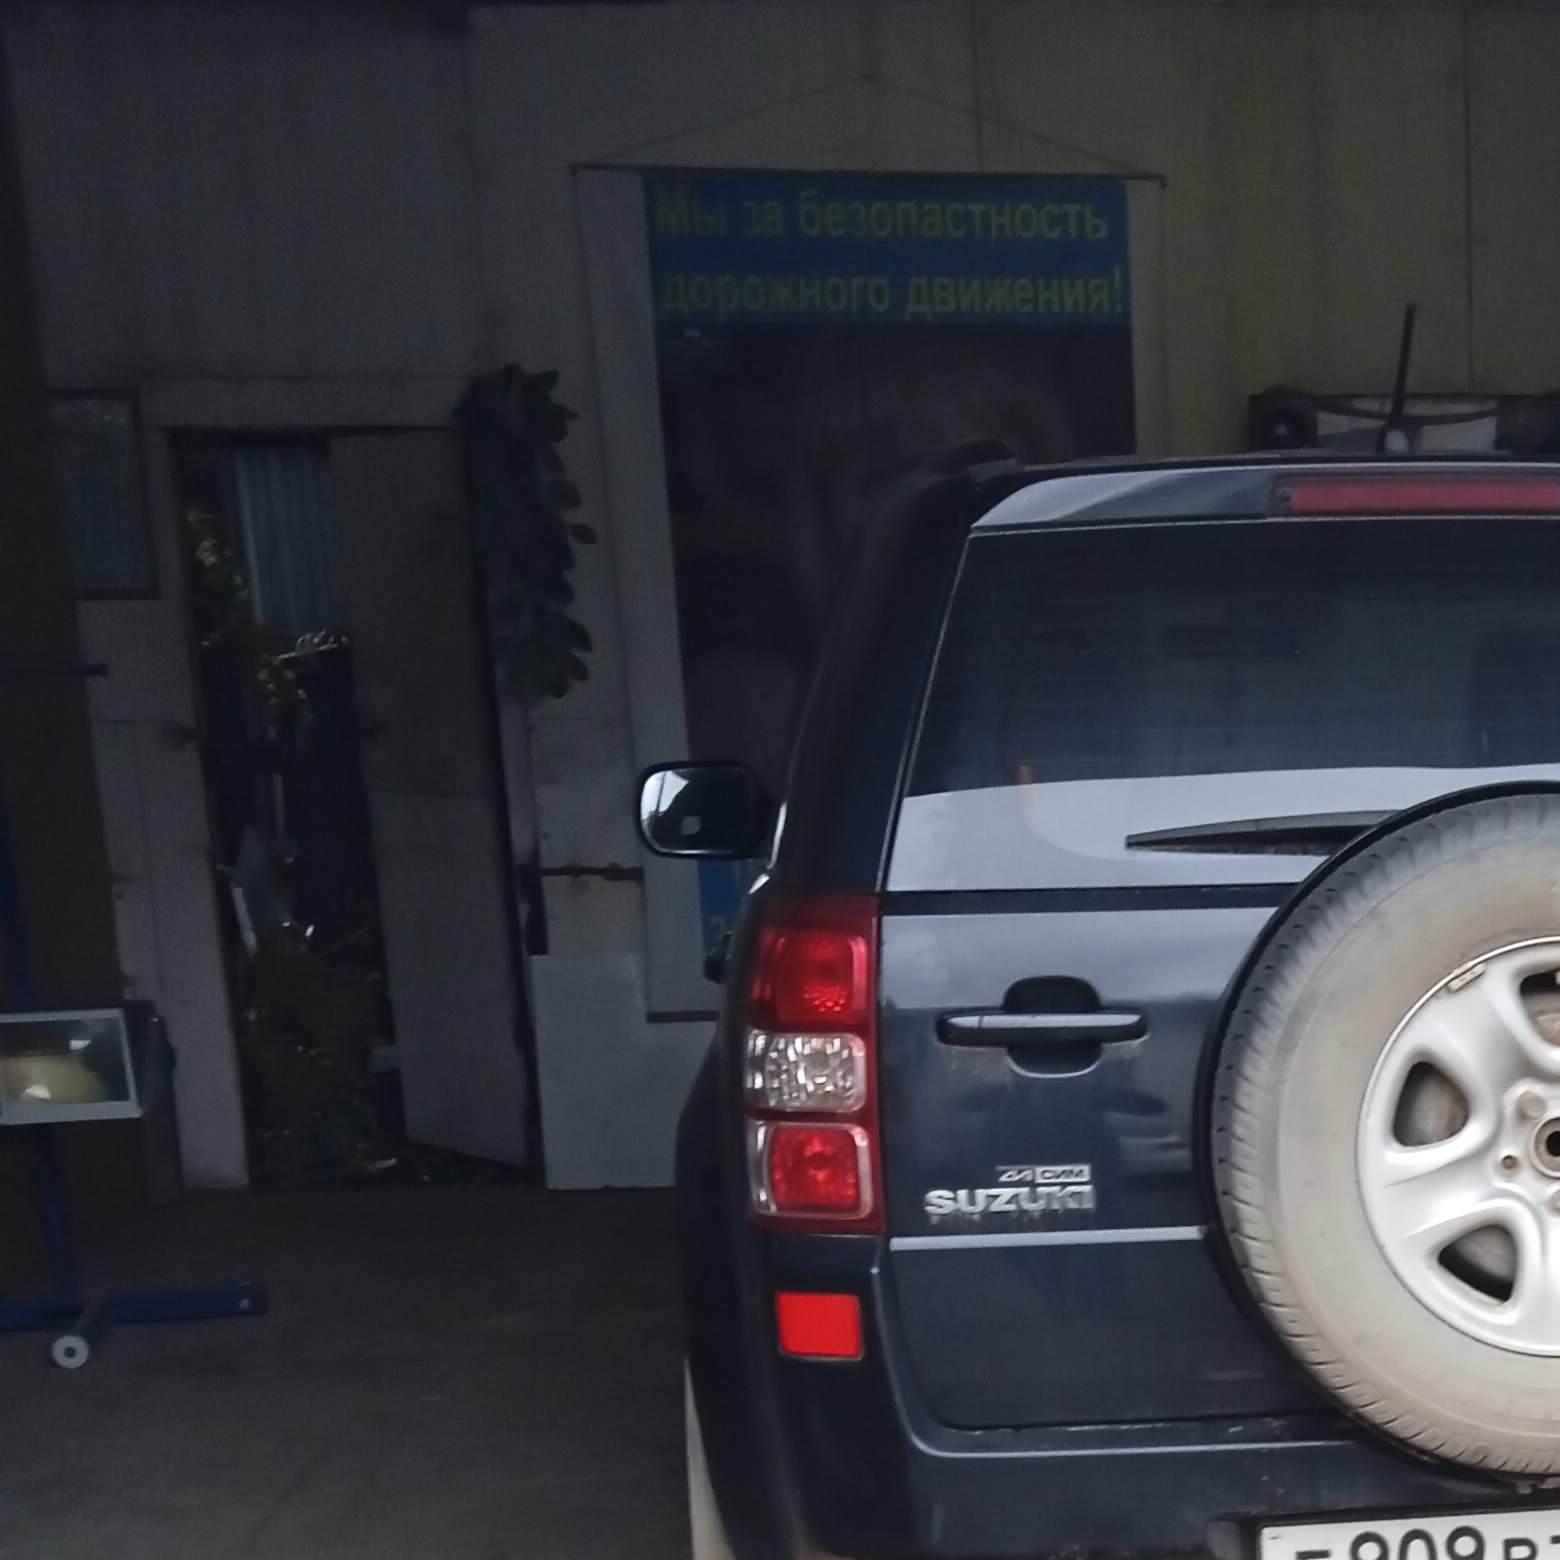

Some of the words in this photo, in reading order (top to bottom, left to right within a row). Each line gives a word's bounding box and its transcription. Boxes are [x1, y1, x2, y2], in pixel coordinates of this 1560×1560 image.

[655, 182, 728, 238] Мы
[743, 199, 786, 238] за
[798, 188, 1107, 240] безопастность
[660, 274, 890, 320] дорожного
[904, 265, 1124, 321] движения!
[925, 1185, 1094, 1215] SUZUKI
